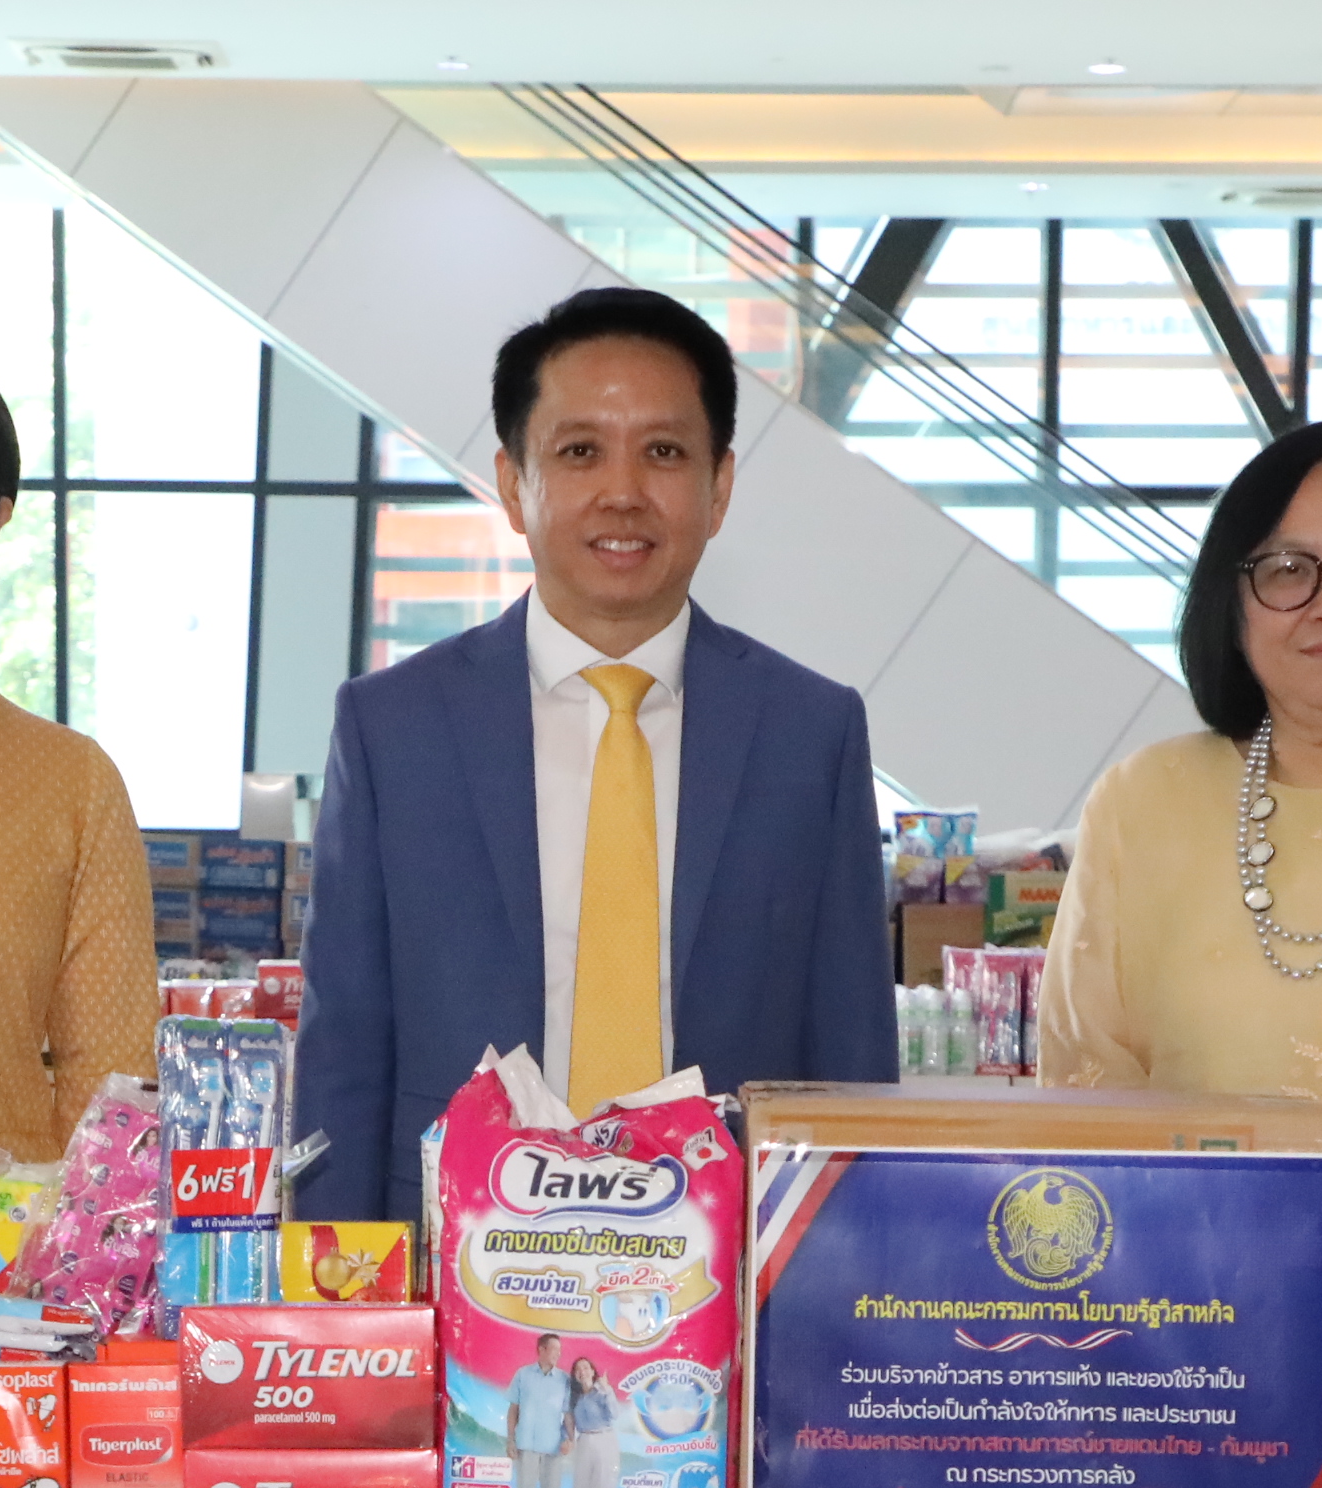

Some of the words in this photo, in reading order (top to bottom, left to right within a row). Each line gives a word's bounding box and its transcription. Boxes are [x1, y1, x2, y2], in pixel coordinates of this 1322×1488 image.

[485, 1226, 687, 1259] กางเกงซึมซับสบาย
[497, 1273, 575, 1294] สวมง่าย
[854, 1292, 1235, 1329] สำนักงานคณะกรรมการนโยบายรัฐวิสาหกิจ
[252, 1341, 418, 1381] TYLENOL
[841, 1361, 1003, 1387] ร่วมบริจาคข้าวสาร
[1008, 1363, 1101, 1388] อาหารแห้ง
[1106, 1365, 1245, 1391] และของใช้จำเป็น
[254, 1385, 314, 1409] 500
[848, 1391, 1117, 1425] เพื่อส่งต่อเป็นกำลังใจให้ทหาร
[1122, 1402, 1236, 1425] และประชาชน
[254, 1412, 304, 1424] paracetamol
[305, 1412, 320, 1423] 500
[322, 1413, 336, 1424] mg
[88, 1437, 163, 1454] Tigerplast
[1220, 1436, 1289, 1464] กัมพูชา
[946, 1465, 967, 1484] ณ
[972, 1461, 1136, 1485] กระทรวงการคลัง
